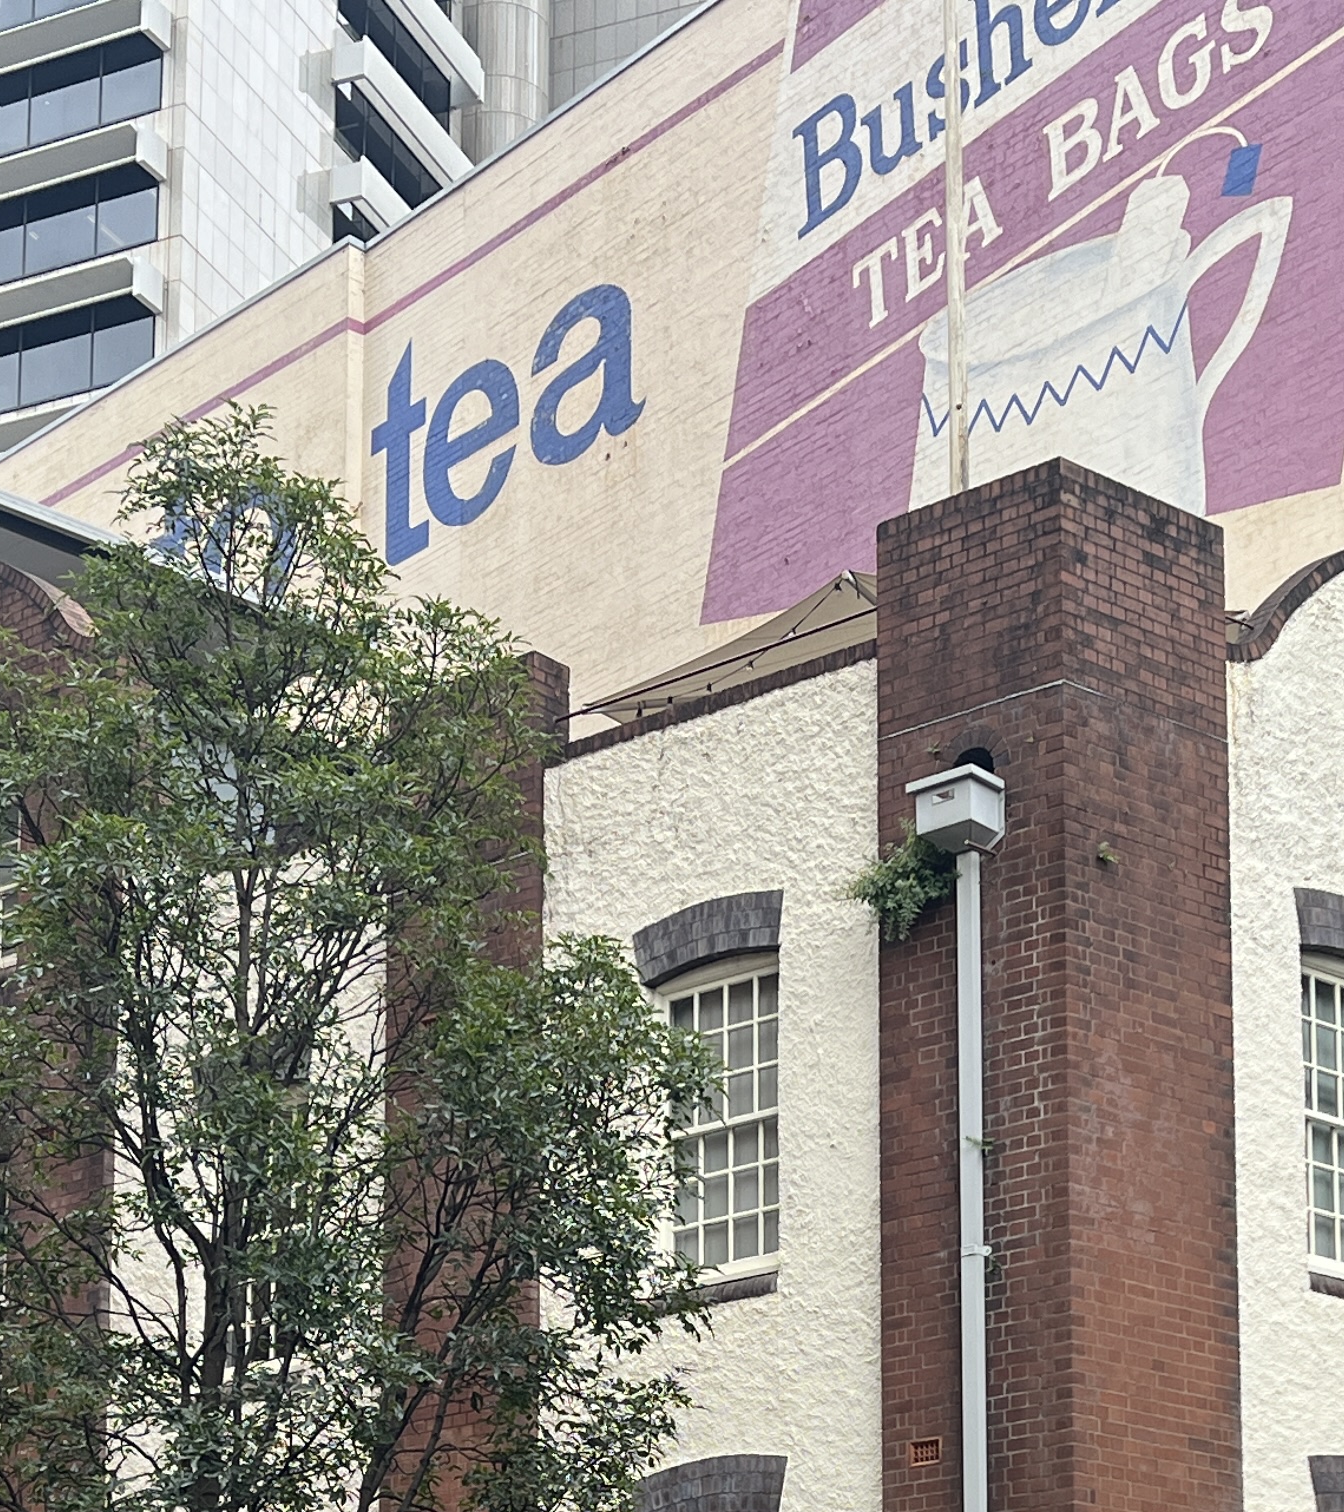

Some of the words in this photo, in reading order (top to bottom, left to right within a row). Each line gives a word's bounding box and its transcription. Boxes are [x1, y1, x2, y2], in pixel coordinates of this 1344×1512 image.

[852, 176, 1004, 329] TEA
[1042, 0, 1274, 202] BAGS
[369, 282, 646, 567] tea
